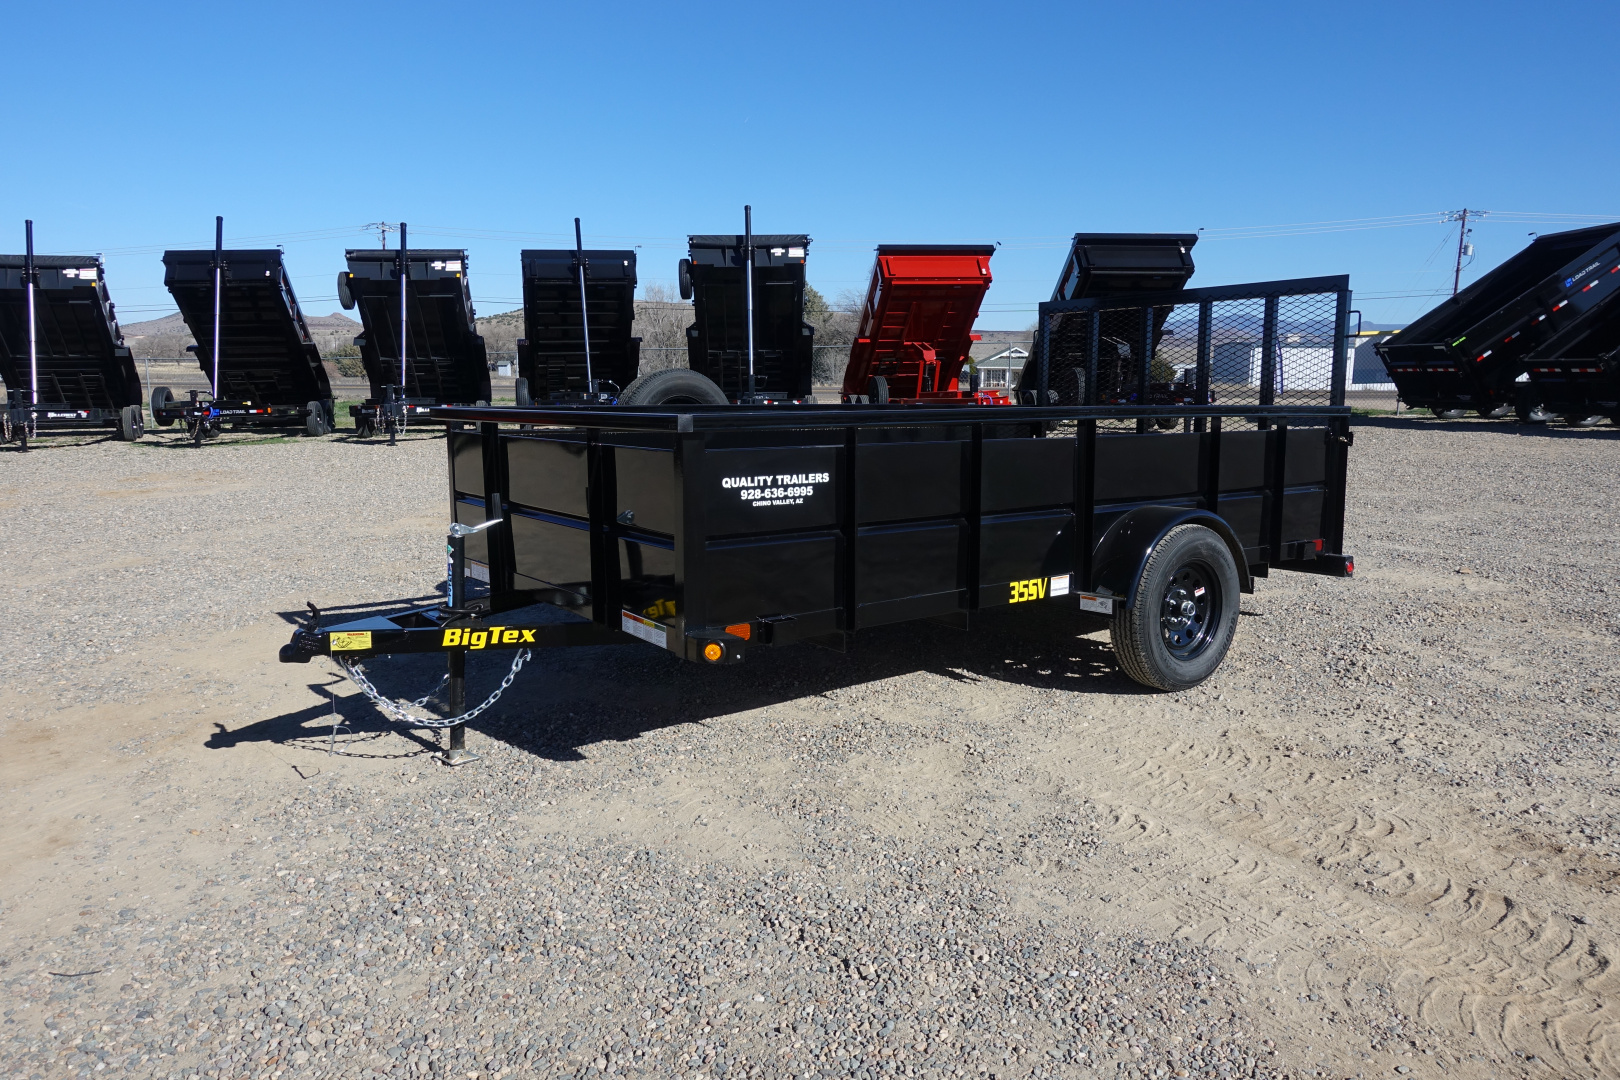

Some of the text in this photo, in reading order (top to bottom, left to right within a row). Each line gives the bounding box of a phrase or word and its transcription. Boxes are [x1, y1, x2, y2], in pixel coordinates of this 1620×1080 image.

[721, 472, 830, 488] QUALITY TRAILERS
[740, 486, 814, 500] 928-636-6995
[442, 626, 537, 650] BigTex
